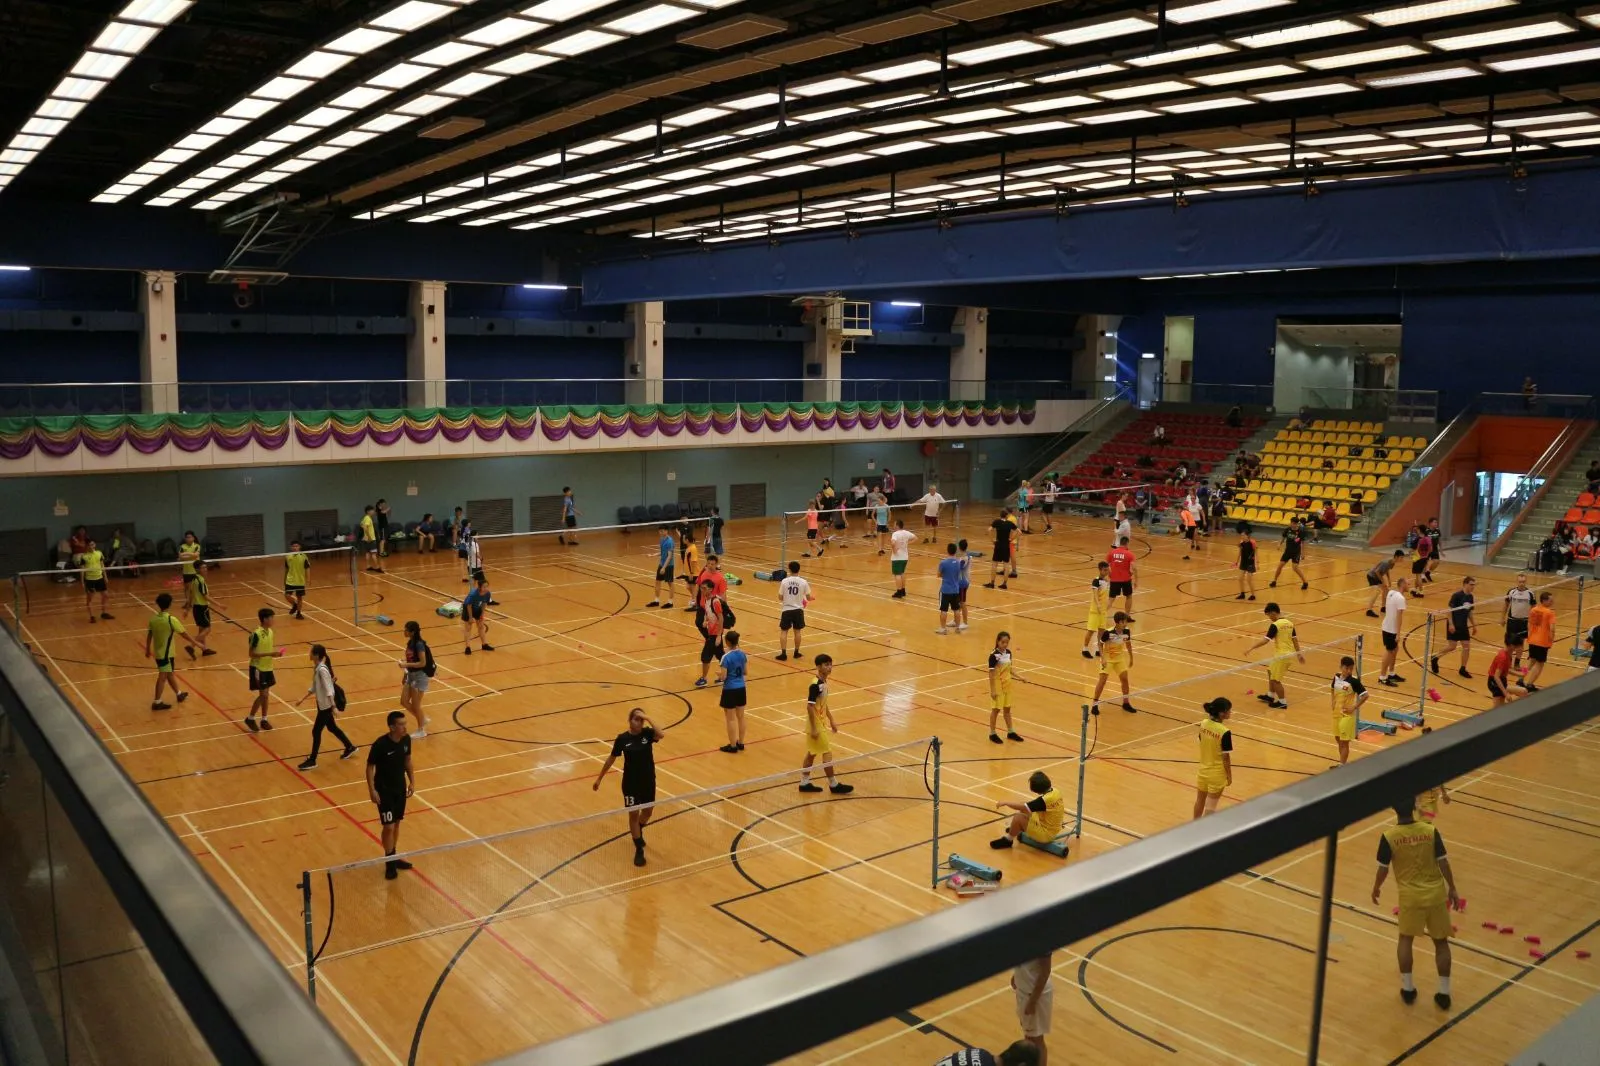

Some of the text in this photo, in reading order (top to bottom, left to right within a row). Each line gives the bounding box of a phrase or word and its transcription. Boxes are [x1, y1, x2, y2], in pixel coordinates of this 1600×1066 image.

[788, 586, 799, 596] 10
[624, 795, 635, 806] 13
[381, 811, 393, 823] 10
[1393, 834, 1432, 846] VIETNAM
